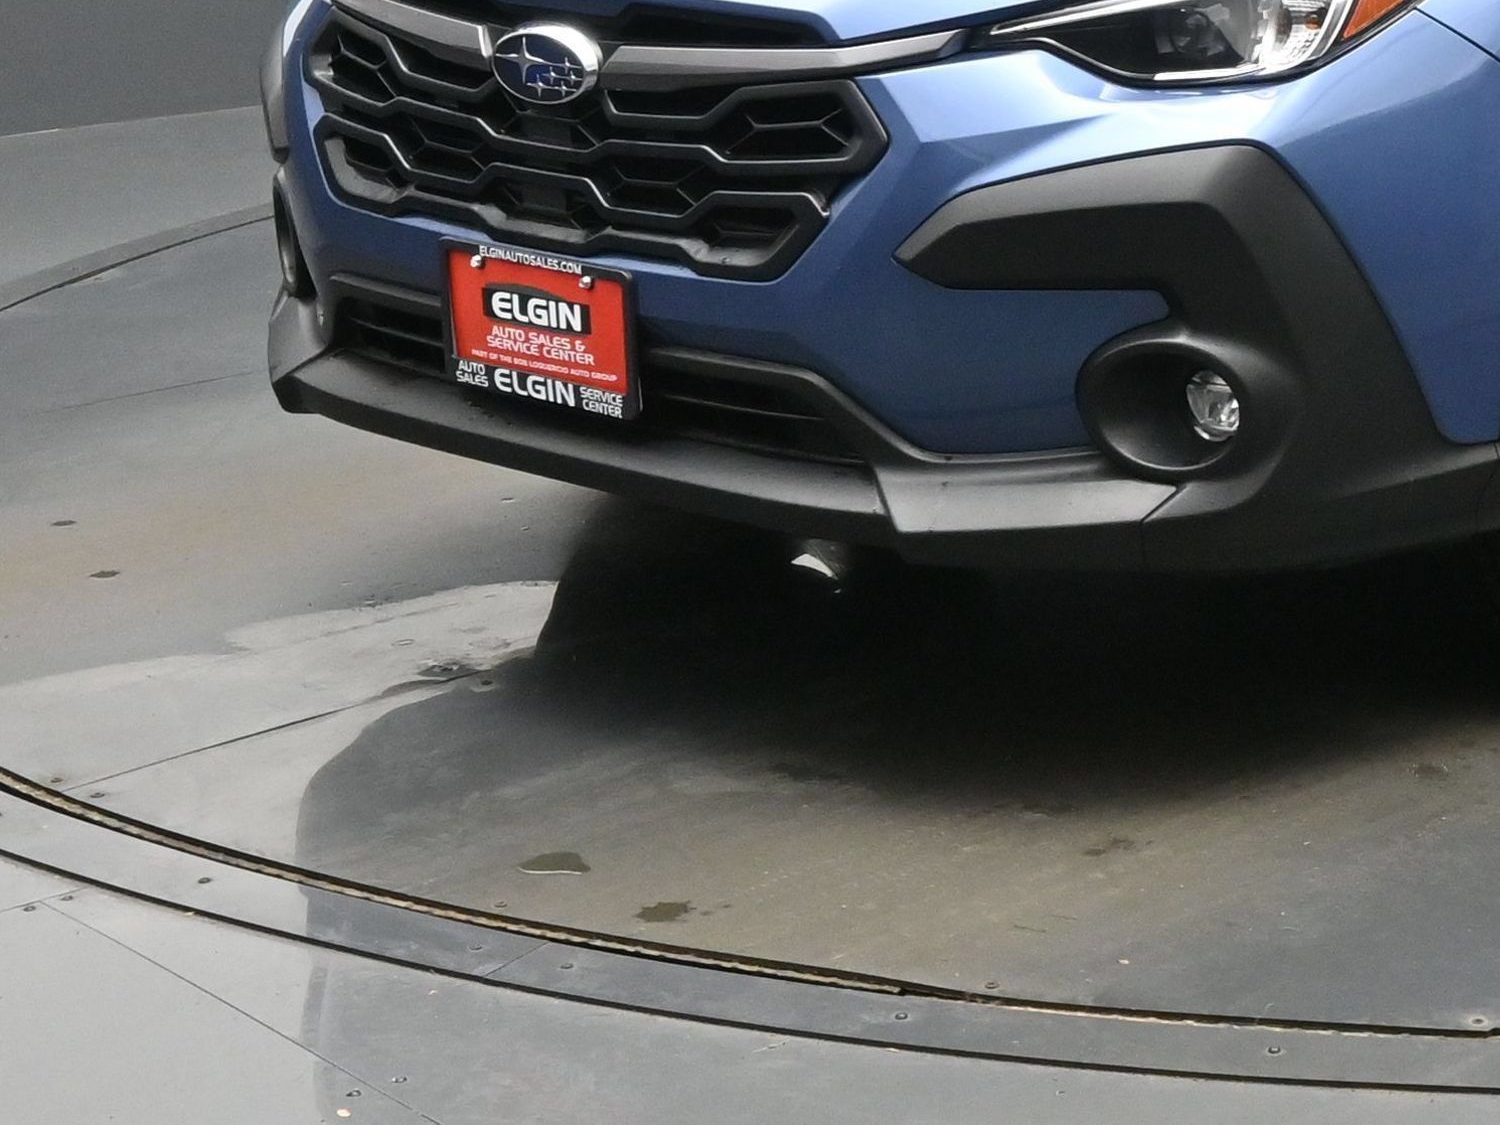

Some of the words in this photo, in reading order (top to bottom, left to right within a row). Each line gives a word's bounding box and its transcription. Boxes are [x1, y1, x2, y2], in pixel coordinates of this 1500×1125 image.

[479, 245, 582, 275] ELGINAUTOSALES.COM
[491, 291, 582, 332] ELGIN
[486, 336, 540, 356] SERVICE
[543, 346, 596, 366] CENTER
[491, 326, 525, 342] AUTO
[528, 332, 571, 350] SALES
[575, 340, 586, 352] &
[455, 371, 489, 388] SALES
[457, 360, 485, 375] AUTO
[493, 368, 576, 407] ELGIN
[579, 386, 624, 407] SERVICE
[582, 399, 623, 419] CENTER
